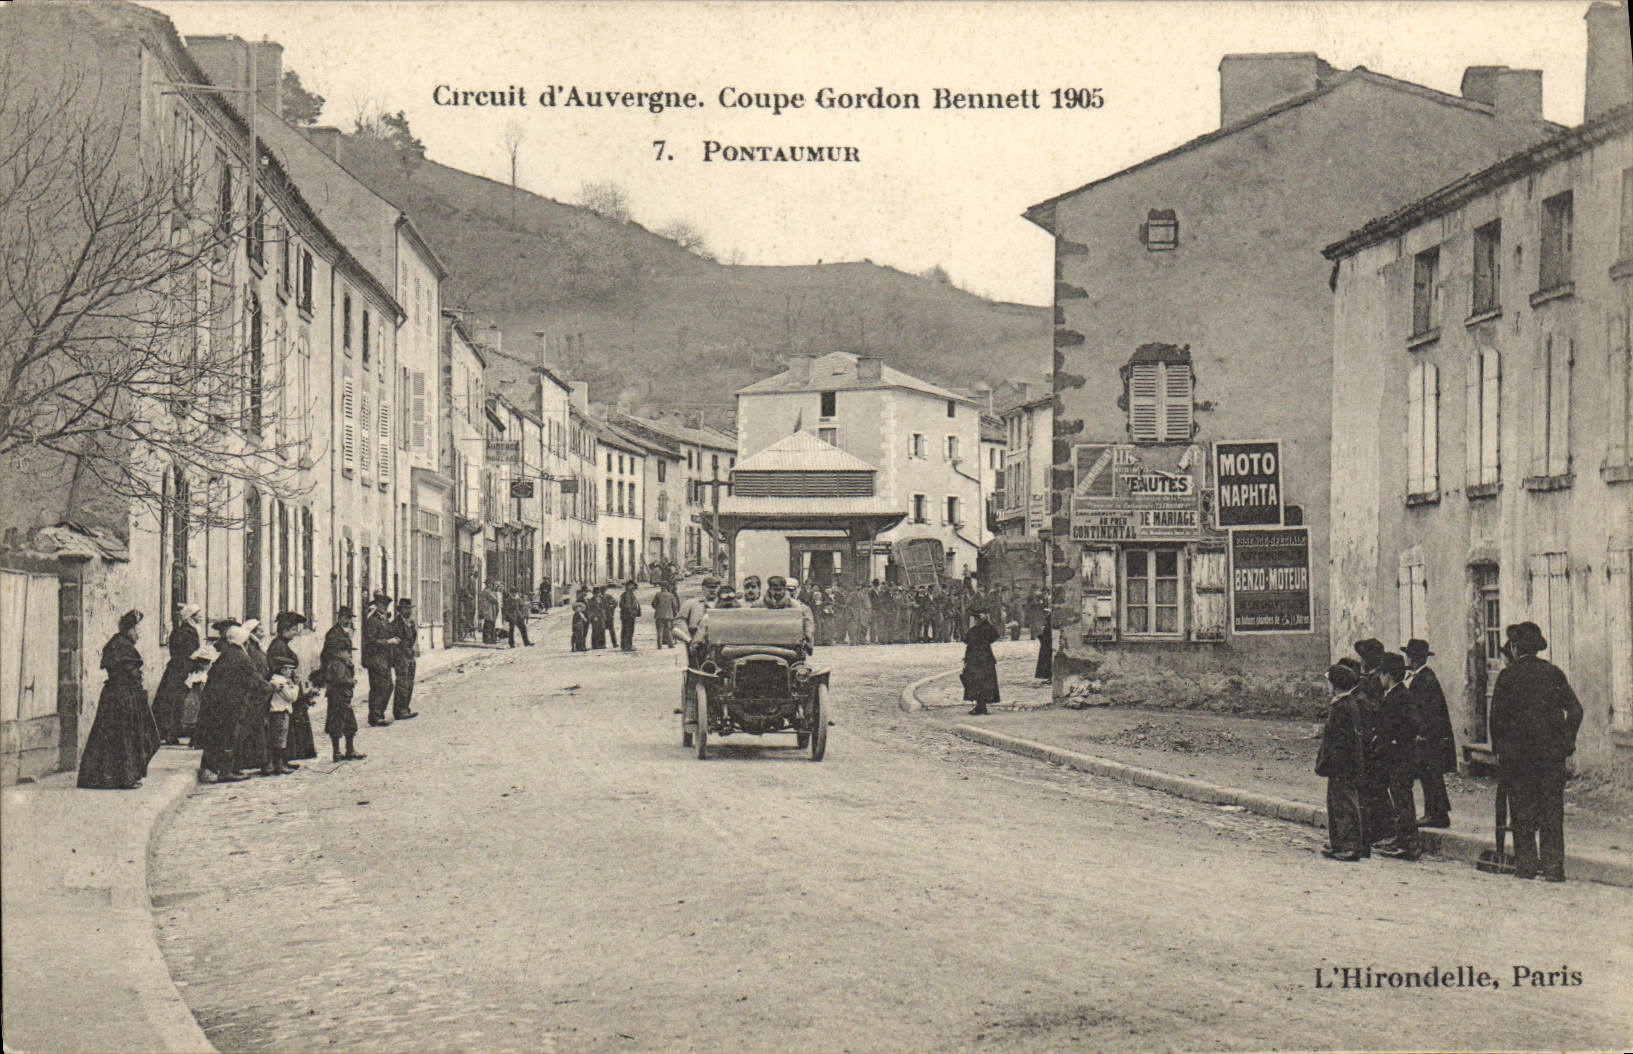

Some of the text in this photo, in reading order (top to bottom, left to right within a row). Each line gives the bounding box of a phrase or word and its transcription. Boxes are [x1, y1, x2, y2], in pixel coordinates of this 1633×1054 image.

[1220, 452, 1275, 476] MOTO
[1221, 483, 1278, 507] NAPHTA
[1153, 511, 1196, 526] MARIAGE
[1073, 525, 1137, 539] CONTINENTAL
